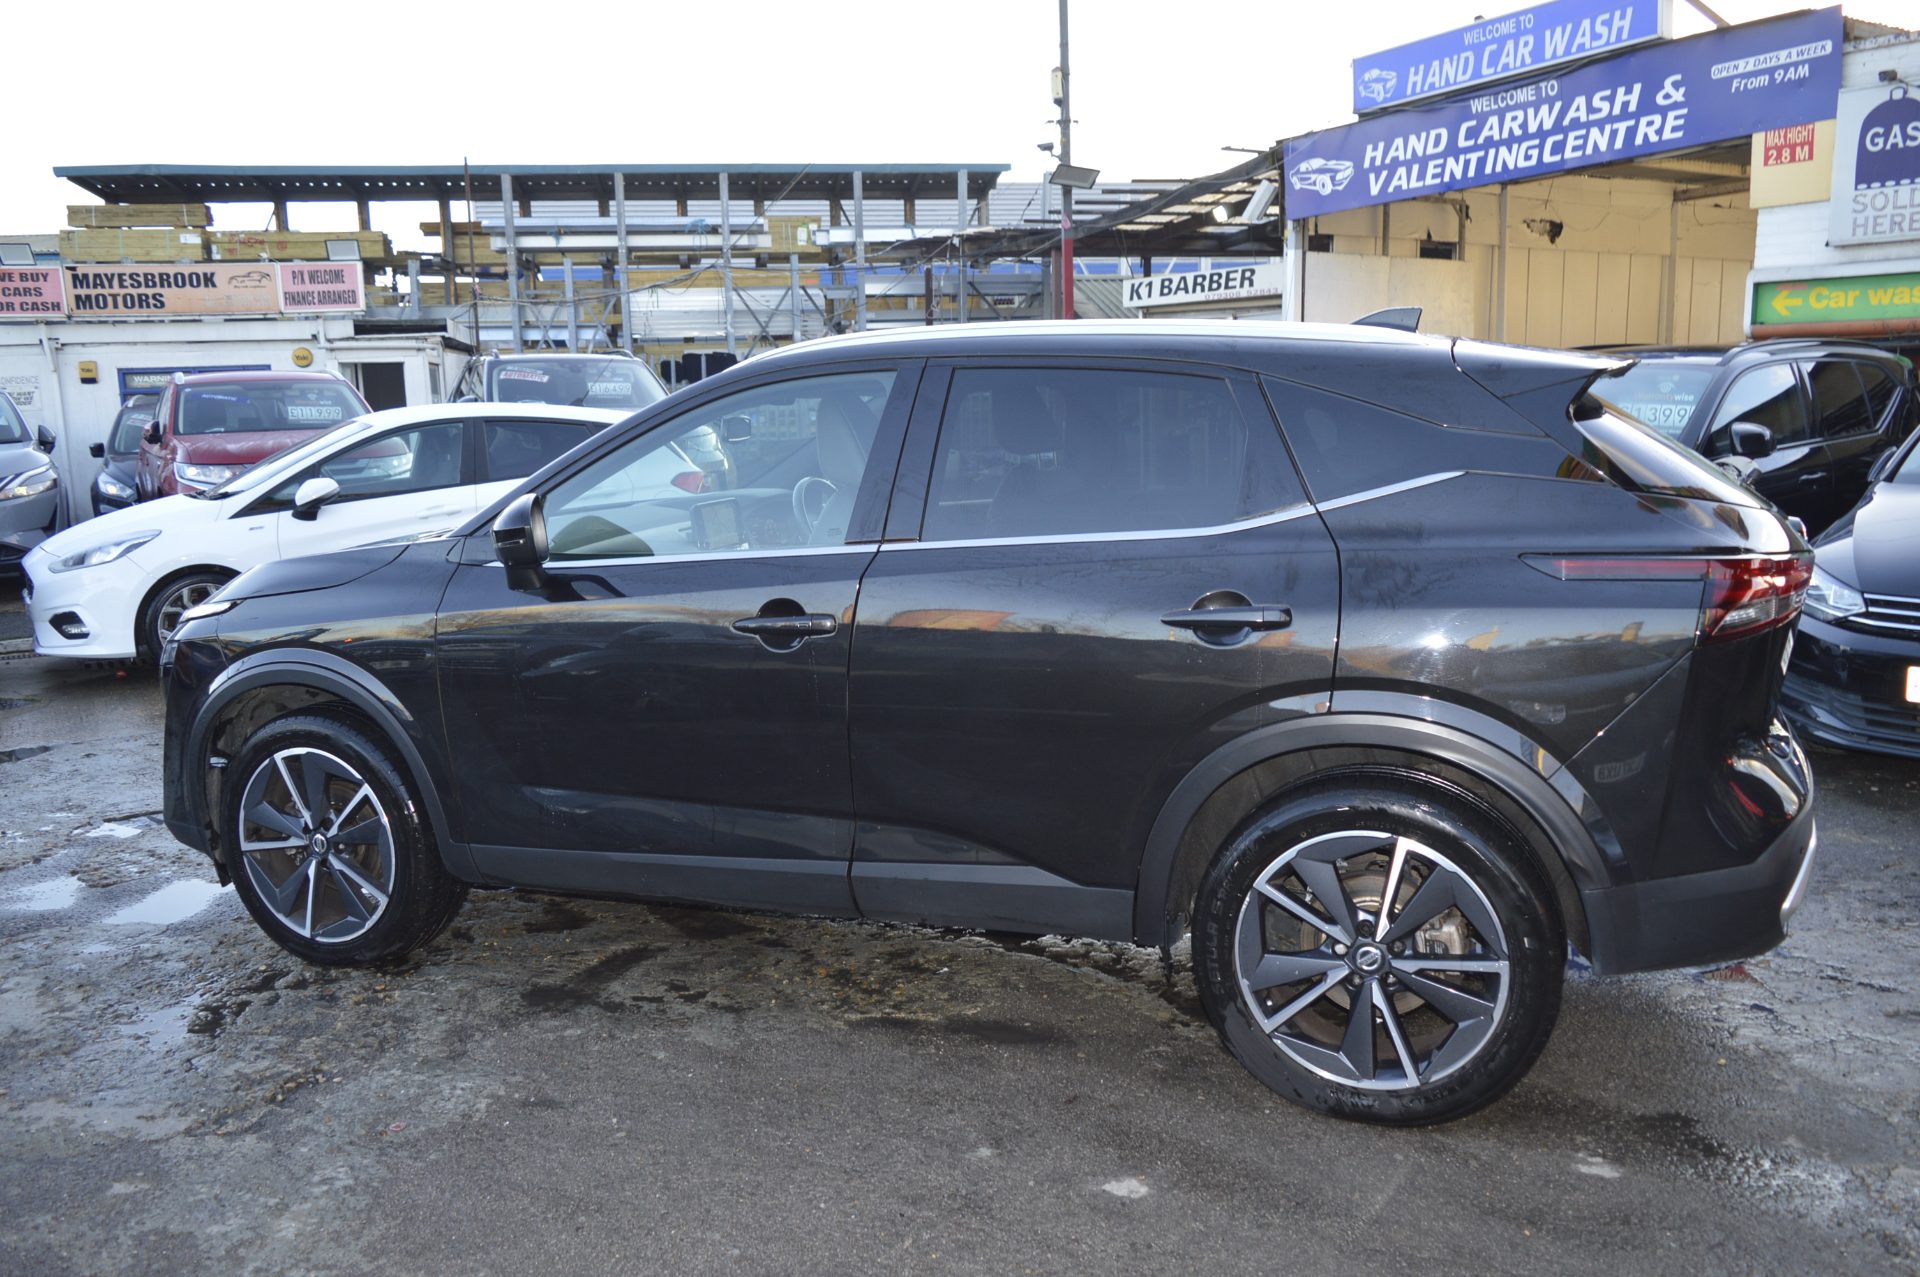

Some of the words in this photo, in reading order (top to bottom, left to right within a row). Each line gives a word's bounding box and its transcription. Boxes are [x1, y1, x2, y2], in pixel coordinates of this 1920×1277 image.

[1463, 19, 1517, 46] WELCOME
[1519, 13, 1534, 29] TO
[1406, 51, 1475, 96] HAND
[1481, 34, 1534, 76] CAR
[1544, 7, 1634, 60] WASH
[1713, 63, 1740, 77] OPEN
[1743, 61, 1749, 71] 7
[1753, 54, 1780, 68] DAYS
[1785, 51, 1792, 61] A
[1796, 42, 1828, 58] WEEK
[1731, 73, 1769, 93] From
[1774, 63, 1809, 84] 9AM
[1470, 86, 1536, 114] WELCOME
[1539, 79, 1558, 97] TO
[1363, 127, 1448, 169] HAND
[1655, 73, 1686, 106] &
[1767, 128, 1785, 147] MAX
[1787, 124, 1813, 144] HIGHT
[1865, 121, 1920, 152] GAS
[1768, 148, 1790, 164] 2.8
[1796, 145, 1809, 161] M
[1851, 211, 1920, 237] HERE
[19, 272, 49, 282] BUY
[71, 272, 217, 289] MAYESBROOK
[307, 269, 345, 285] WELCOME
[1129, 281, 1153, 301] K1
[1159, 268, 1256, 297] BARBER
[2, 287, 43, 297] CARS
[74, 293, 166, 310] MOTORS
[284, 291, 316, 306] FINANCE
[317, 290, 357, 305] ARRANGED
[1808, 286, 1860, 309] Car
[20, 301, 61, 311] CASH
[133, 375, 171, 383] WARNI
[290, 407, 341, 418] £11999
